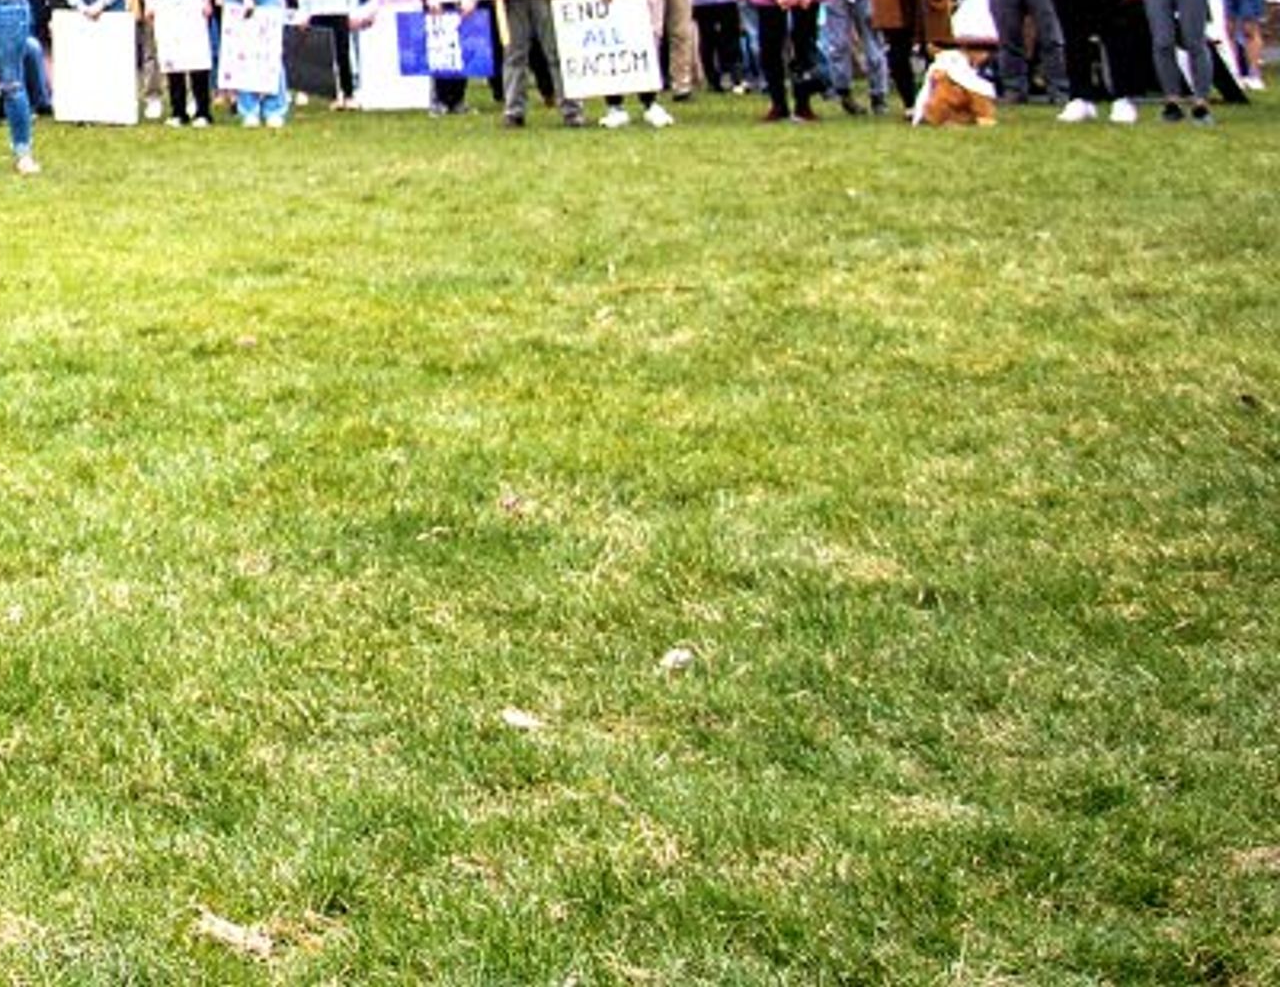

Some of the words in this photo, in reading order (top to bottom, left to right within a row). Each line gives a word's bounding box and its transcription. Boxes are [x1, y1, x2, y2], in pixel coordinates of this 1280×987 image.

[561, 0, 610, 23] END
[582, 27, 625, 47] ALL
[565, 50, 649, 78] RACISM
